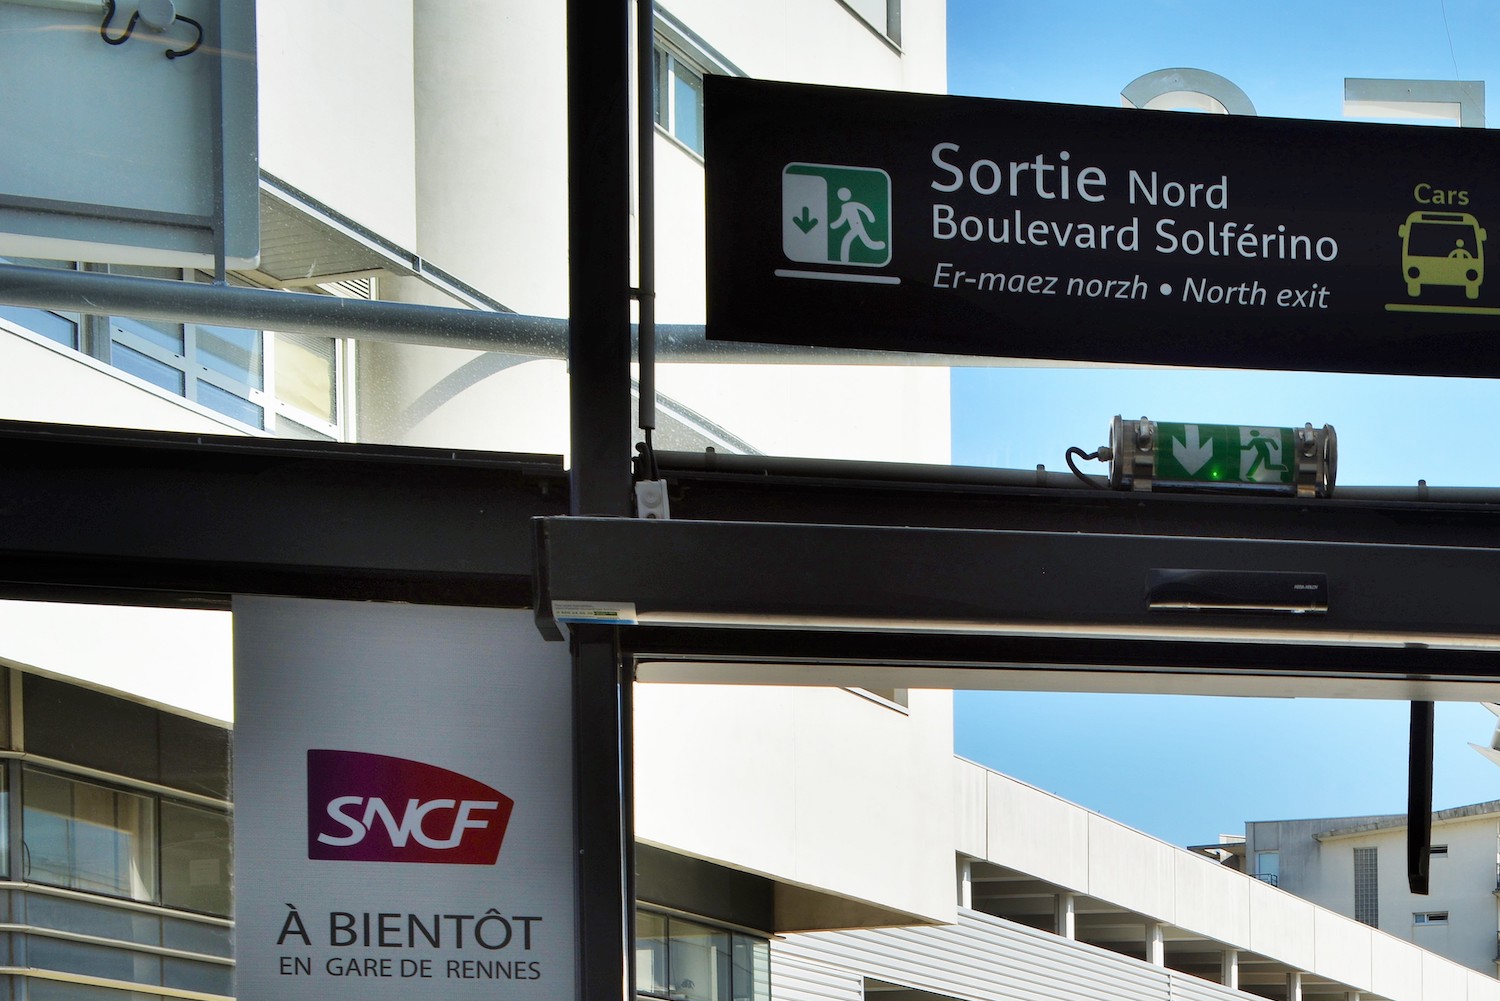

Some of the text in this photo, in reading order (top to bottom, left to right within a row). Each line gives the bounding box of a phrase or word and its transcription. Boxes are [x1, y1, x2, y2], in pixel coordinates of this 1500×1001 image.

[930, 141, 1229, 210] Sortie Nord
[1413, 182, 1470, 206] Cars
[931, 203, 1339, 262] Boulevard Solférino
[932, 262, 1331, 309] Er-maez norzh North exit
[316, 795, 499, 850] SNCF
[276, 903, 543, 951] À BIENTÔT
[279, 956, 541, 980] EN GARE DE RENNES
